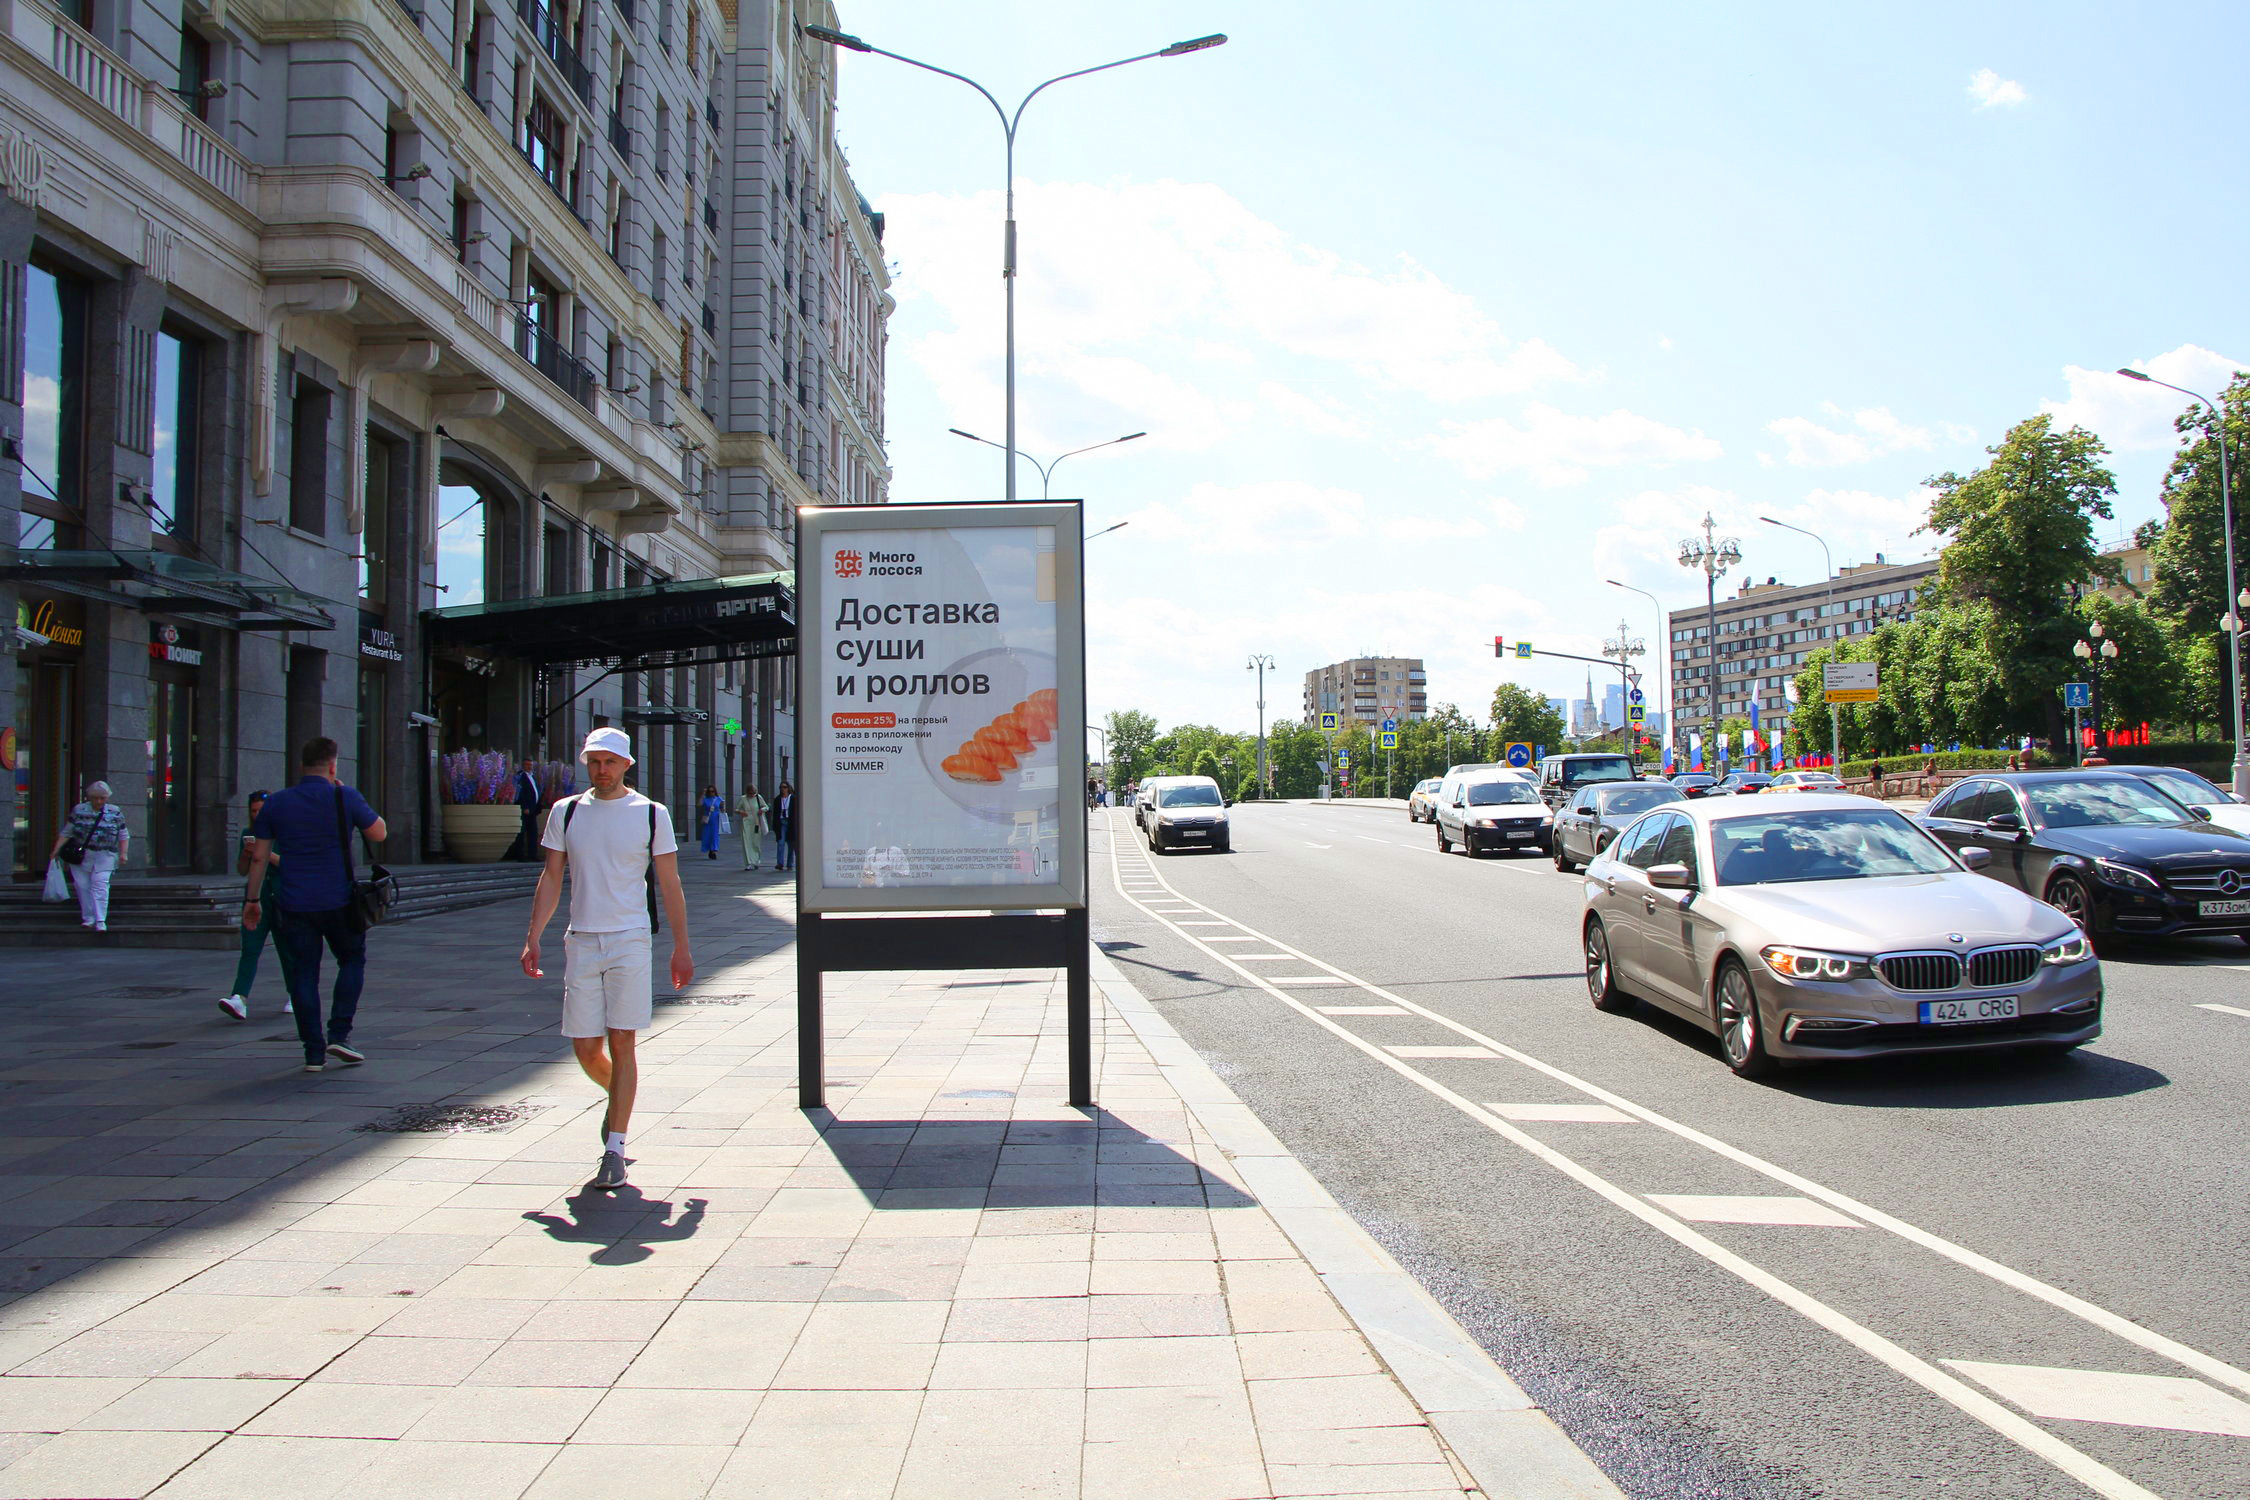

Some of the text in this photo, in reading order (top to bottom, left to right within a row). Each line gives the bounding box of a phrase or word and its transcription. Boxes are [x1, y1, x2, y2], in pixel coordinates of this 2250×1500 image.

[869, 551, 915, 562] Много
[868, 566, 922, 576] лосося
[835, 598, 1000, 631] Доставка
[371, 628, 395, 648] YURA
[361, 642, 389, 659] Restaurant
[393, 650, 402, 661] Bar
[836, 639, 924, 667] суши
[837, 673, 990, 702] и роллов
[835, 716, 871, 726] Скидка
[873, 715, 894, 725] 25%
[911, 715, 948, 727] первый
[835, 731, 862, 739] заказ
[872, 730, 932, 740] приложении
[849, 745, 903, 754] промокоду
[835, 761, 884, 771] SUMMER
[1033, 846, 1049, 877] 0+
[1936, 1002, 1968, 1020] 424
[1978, 998, 2015, 1017] CRG
